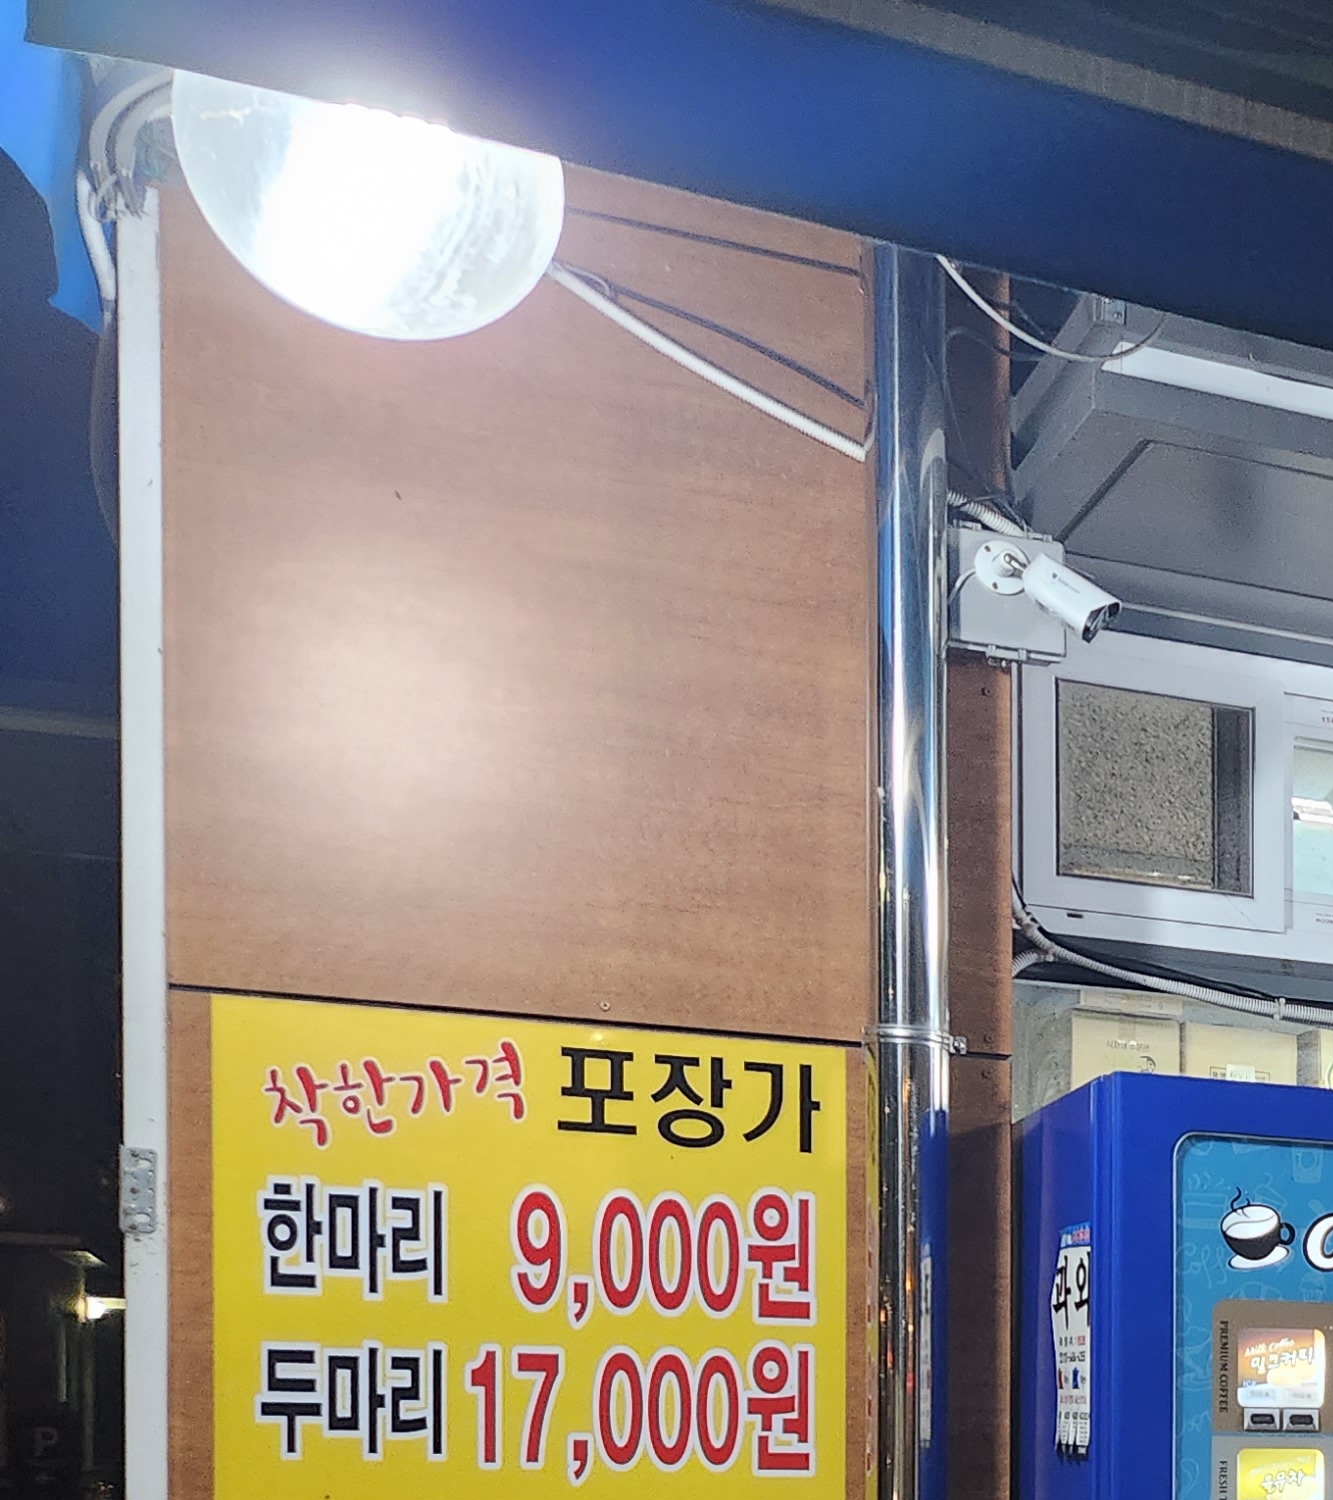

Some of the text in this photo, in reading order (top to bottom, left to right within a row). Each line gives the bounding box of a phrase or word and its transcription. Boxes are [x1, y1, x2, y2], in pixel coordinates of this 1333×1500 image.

[264, 1041, 821, 1153] 착한가격 포장가
[260, 1178, 815, 1327] 한마리 9,000원
[1218, 1320, 1229, 1413] PREMIUM COFFEE
[1251, 1346, 1314, 1375] 밀크커피
[259, 1343, 815, 1484] 두마리 17,000원
[1218, 1459, 1228, 1495] FRESH
